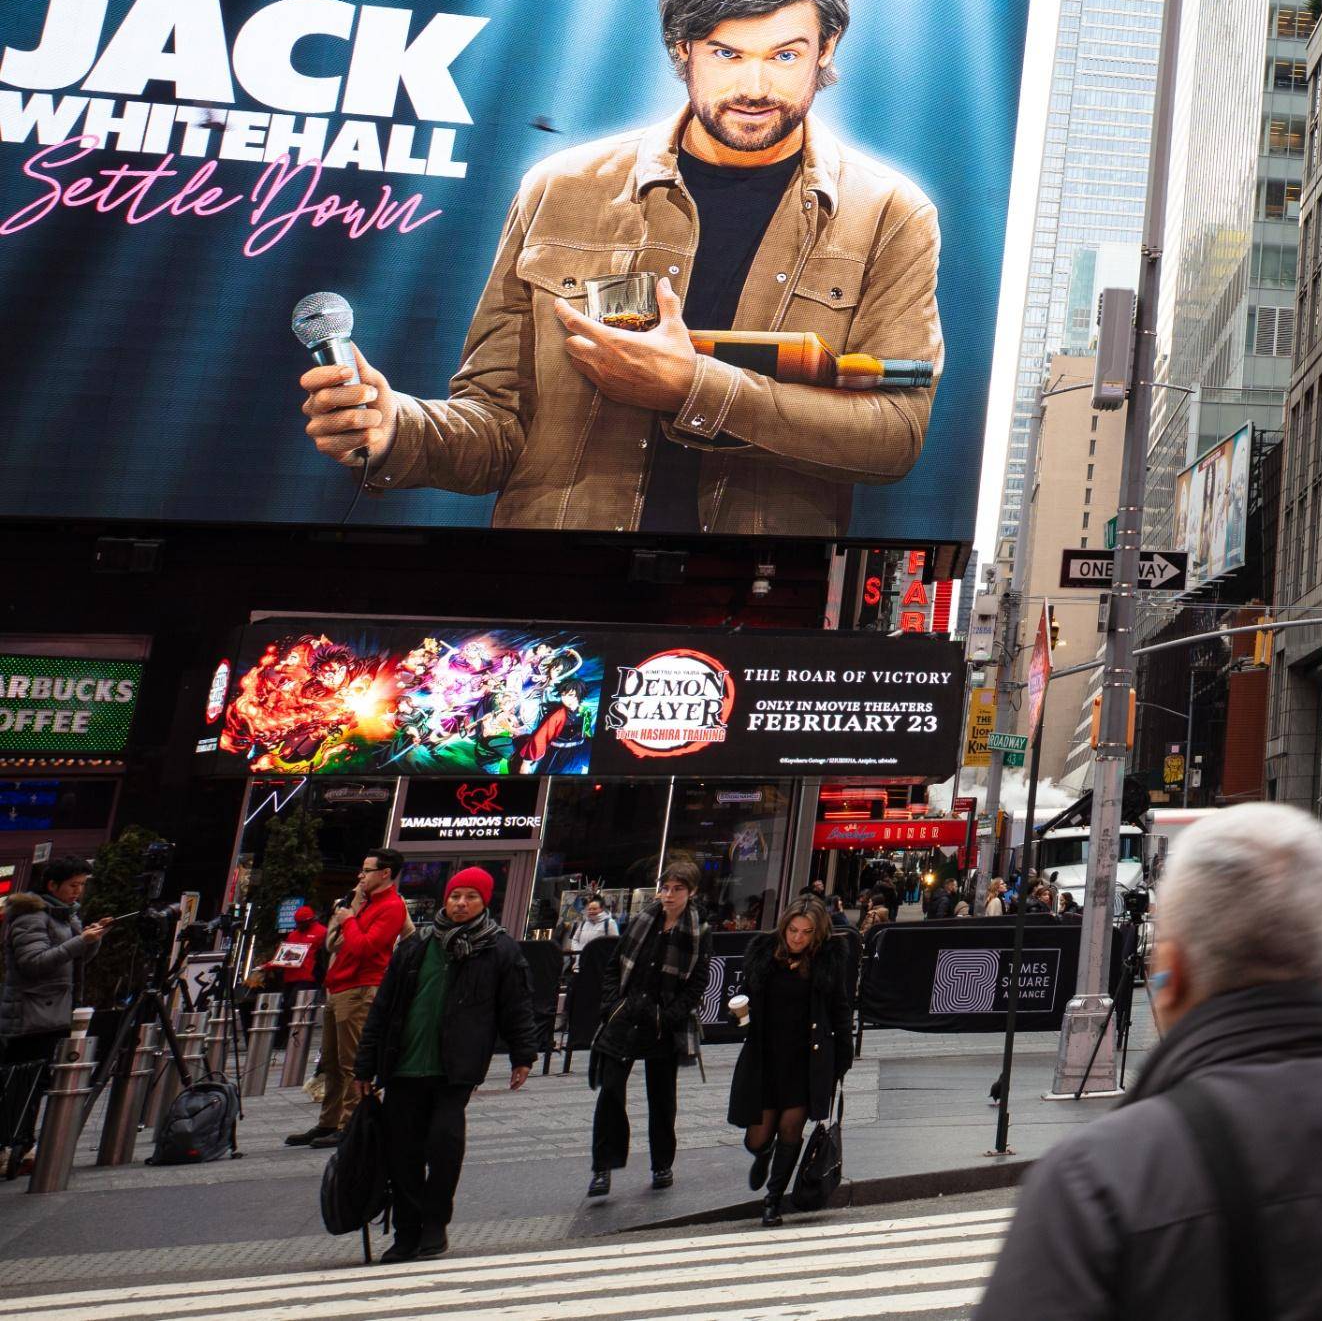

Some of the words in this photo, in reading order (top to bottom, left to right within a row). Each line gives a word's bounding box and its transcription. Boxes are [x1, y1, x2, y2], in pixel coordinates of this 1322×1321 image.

[0, 91, 467, 178] WHITEHALL
[0, 135, 244, 235] Settle
[243, 153, 442, 257] Down
[1080, 561, 1113, 577] ONE
[611, 666, 729, 698] DEMON
[744, 669, 780, 681] THE
[786, 669, 837, 683] ROAR
[842, 670, 866, 683] OF
[872, 671, 952, 684] VICTORY
[756, 700, 795, 711] ONLY
[796, 701, 813, 711] IN
[815, 701, 861, 712] MOVIE
[864, 702, 933, 713] THEATERS
[605, 697, 728, 730] SLAYER
[976, 715, 992, 723] THE
[747, 713, 902, 732] FEBRUARY
[907, 715, 938, 732] 23
[616, 729, 626, 739] TO
[626, 730, 639, 739] THE
[640, 729, 681, 741] HASHIRA
[682, 729, 725, 742] TRAINING
[968, 740, 989, 754] KIN
[452, 816, 502, 828] NATIONS
[504, 816, 541, 827] STORE
[440, 828, 464, 837] NEW
[469, 828, 500, 837] YORK
[883, 827, 939, 840] DINER
[1008, 963, 1048, 974] TMES
[1003, 990, 1046, 999] AIANCE
